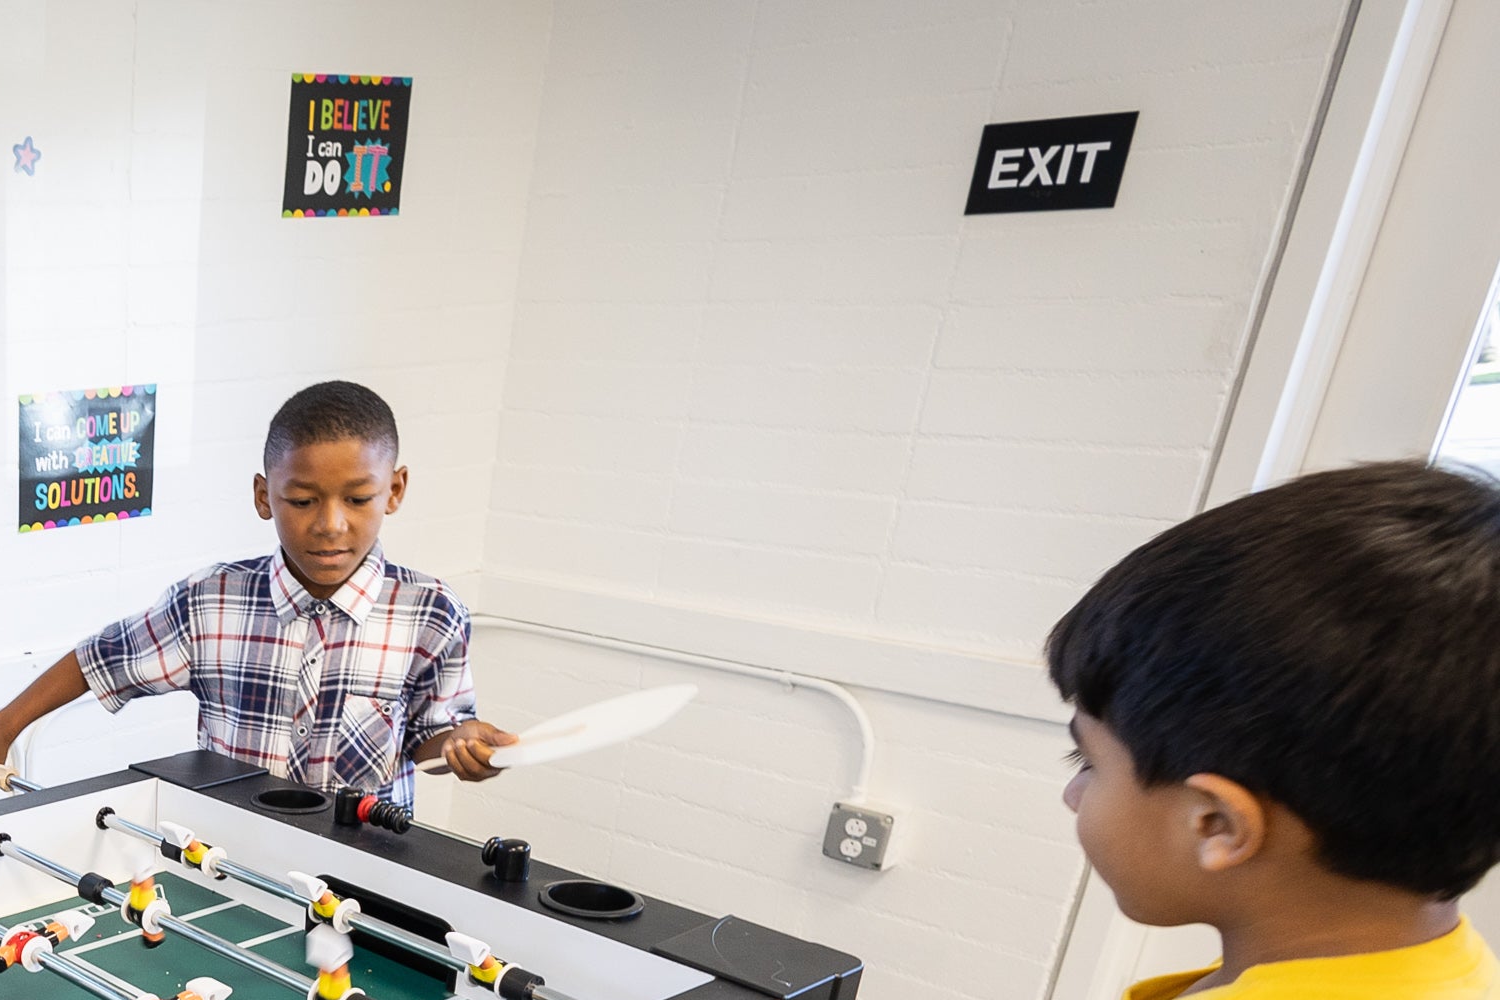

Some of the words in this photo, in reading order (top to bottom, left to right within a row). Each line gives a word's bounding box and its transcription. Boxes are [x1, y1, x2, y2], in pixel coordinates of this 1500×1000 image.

[309, 99, 316, 132] I
[320, 98, 391, 132] BELIEVE
[306, 135, 315, 157] I
[318, 141, 342, 157] can
[303, 159, 342, 196] DO
[987, 141, 1112, 189] EXIT
[34, 421, 42, 443] I
[46, 424, 72, 441] can
[76, 411, 118, 439] COME
[120, 410, 141, 434] UP
[35, 450, 69, 473] with
[75, 441, 137, 468] CREATIVE
[35, 472, 140, 510] SOLUTIONS.
